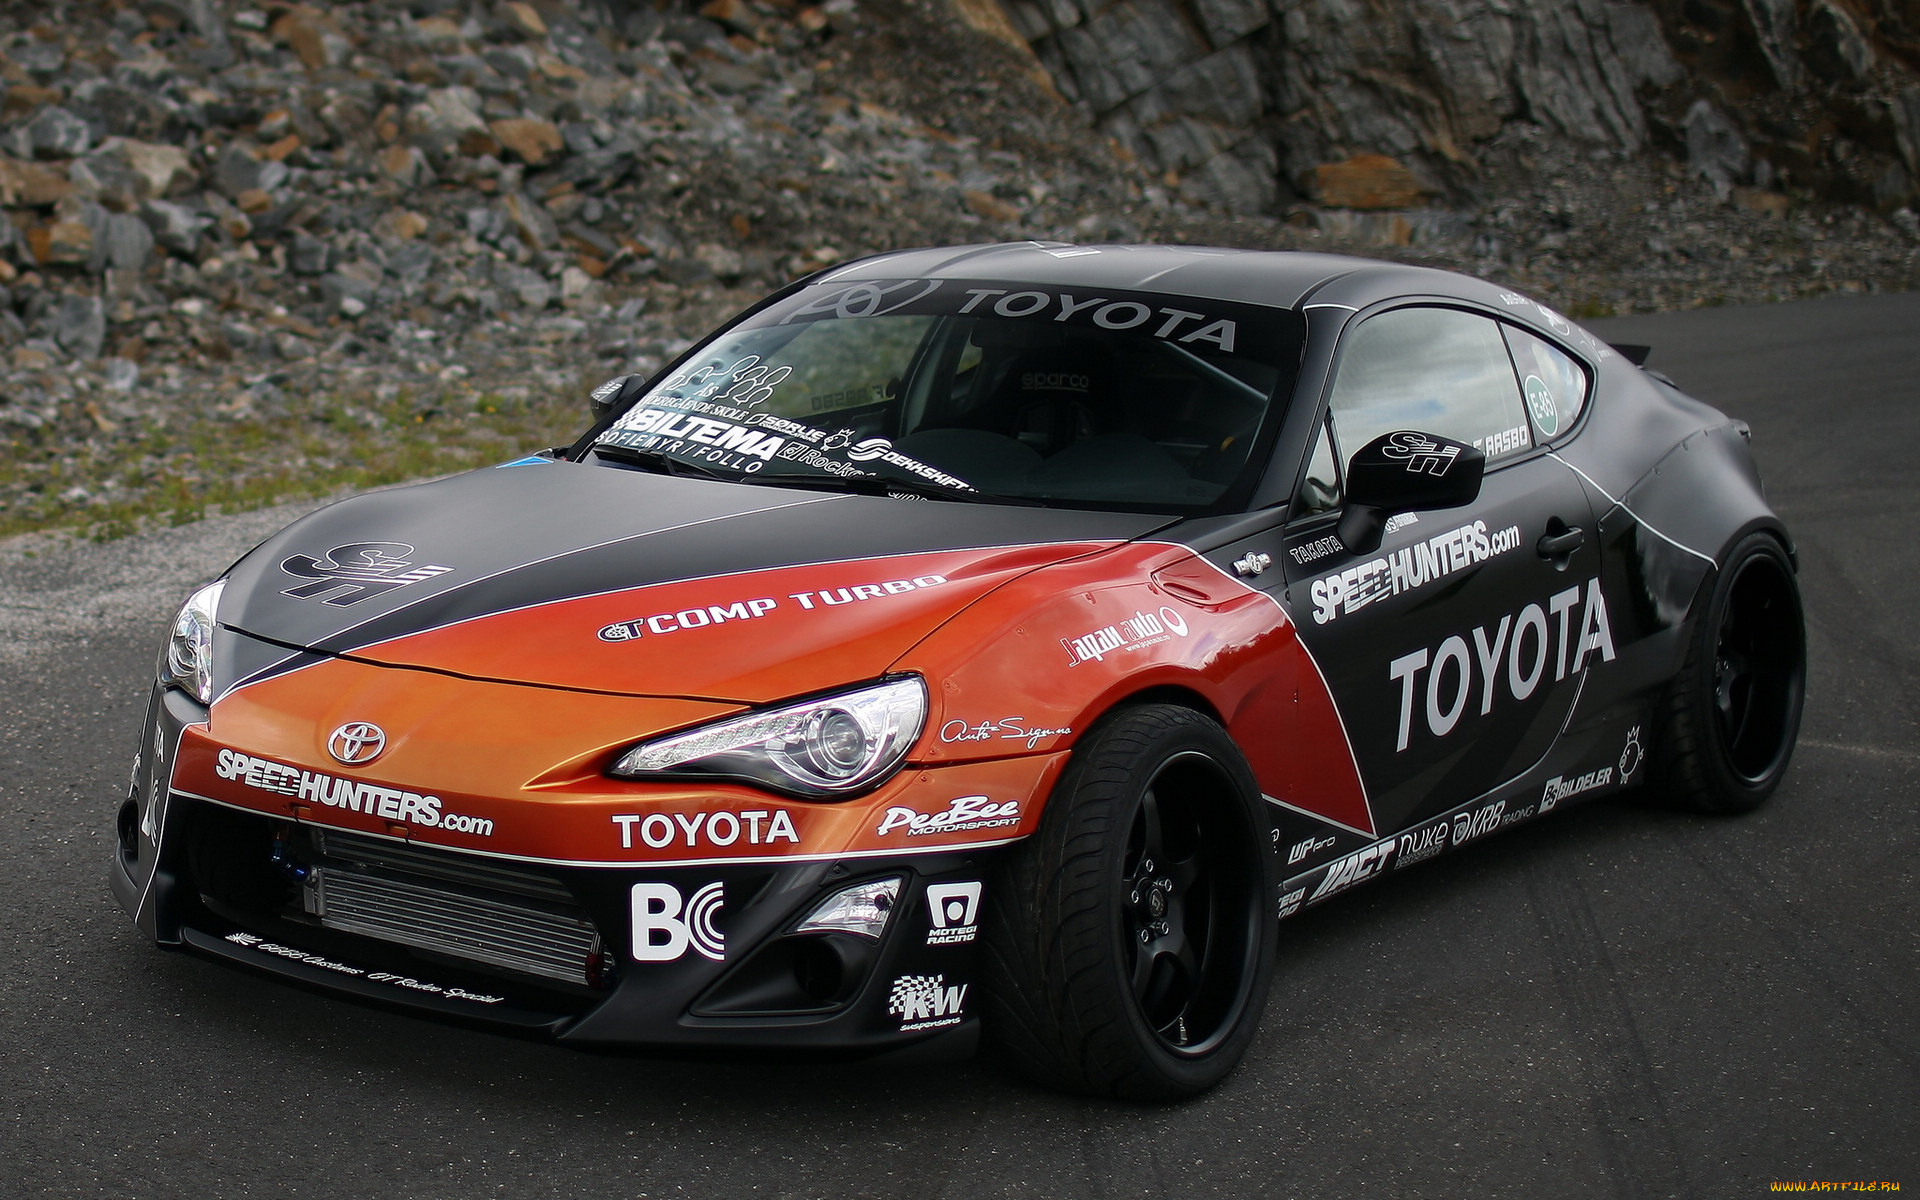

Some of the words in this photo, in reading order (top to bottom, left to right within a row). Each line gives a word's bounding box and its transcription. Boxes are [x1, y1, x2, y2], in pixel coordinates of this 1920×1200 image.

[958, 288, 1237, 353] TOYOTA
[1021, 373, 1089, 391] sparco
[711, 403, 750, 421] SKOLE
[1530, 391, 1555, 419] E-85
[594, 431, 685, 453] SOFIEMYR
[693, 446, 763, 474] FOLLO
[622, 408, 786, 462] BILTEMA
[1289, 535, 1344, 564] TAKATA
[1310, 519, 1521, 625] SPEEDHUNTERS.com
[646, 598, 777, 635] COMP
[788, 575, 949, 610] TURBO
[1389, 577, 1616, 753] TOYOTA
[215, 748, 494, 837] SPEEDHUNTERS.com
[1557, 766, 1613, 801] BILDELER
[612, 810, 800, 849] TOYOTA
[907, 817, 1021, 837] MOTORSPORT
[928, 925, 978, 937] MOTEGI
